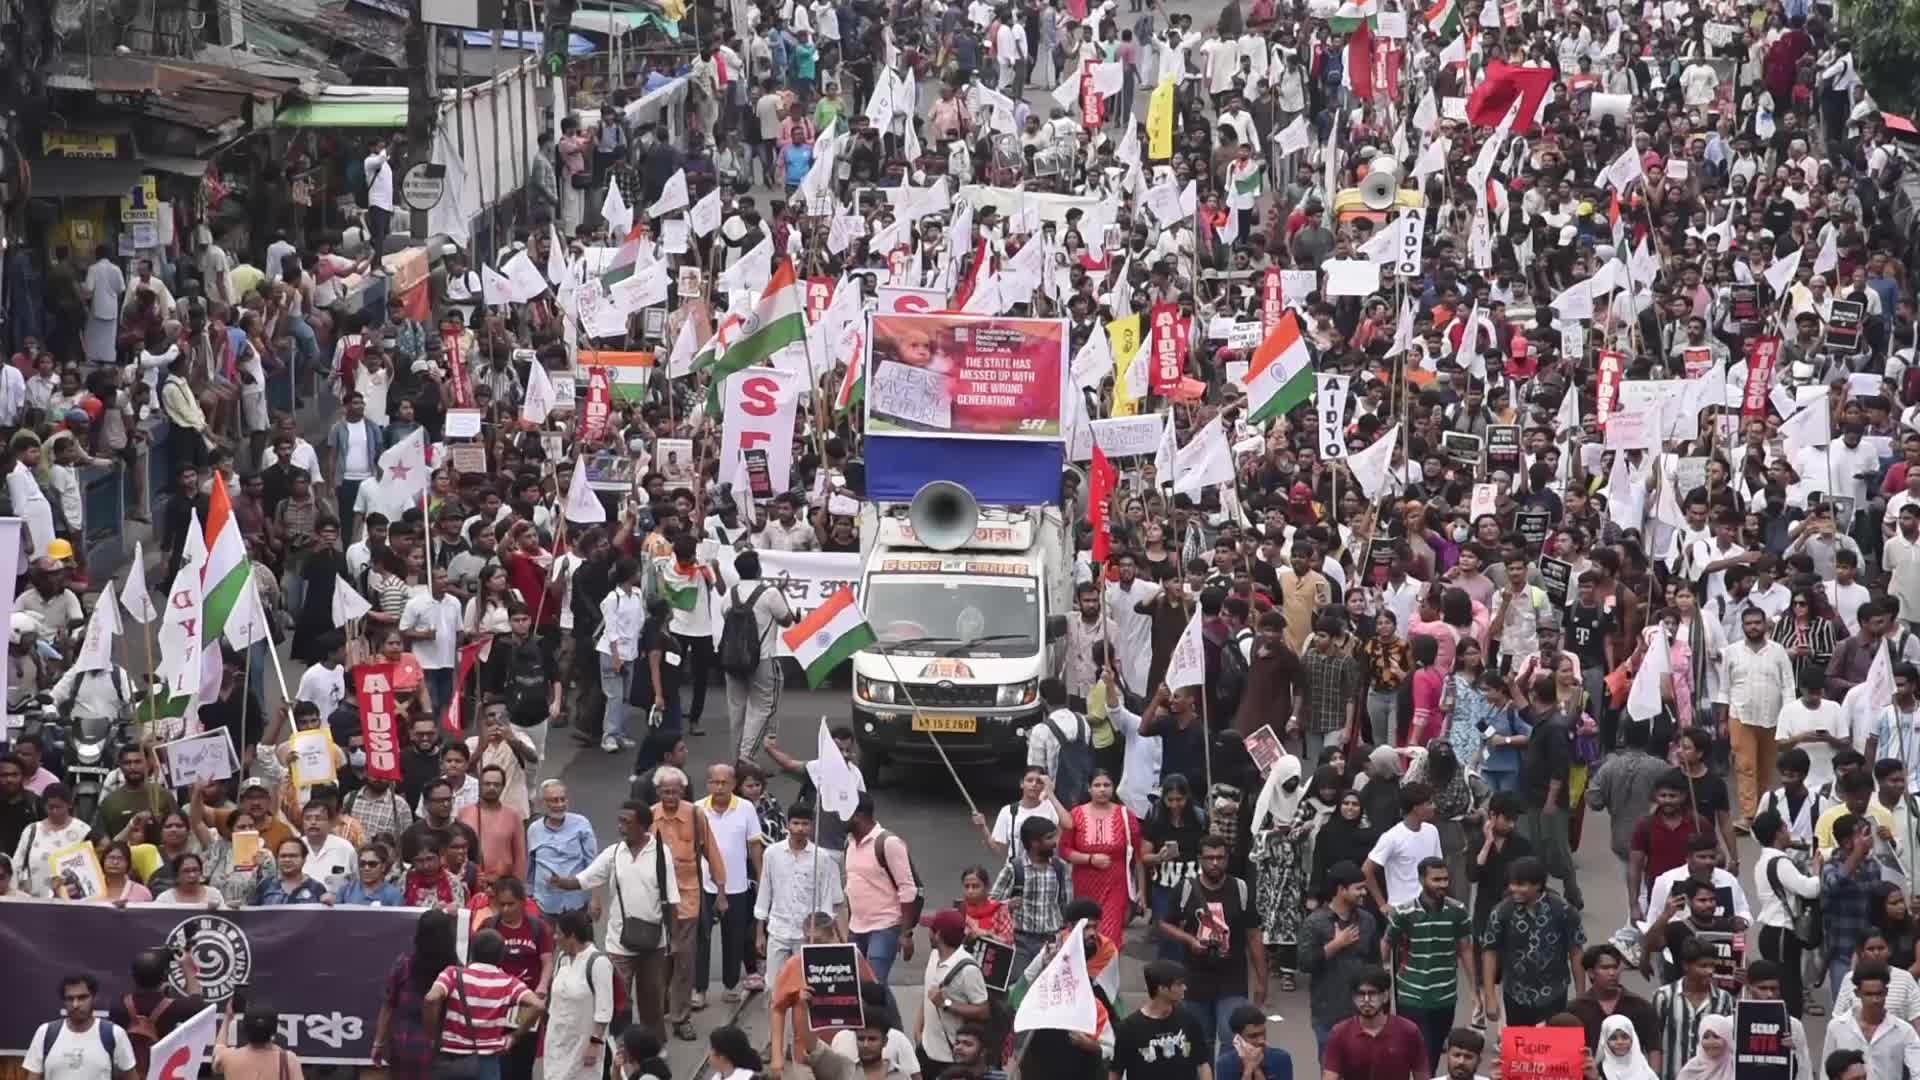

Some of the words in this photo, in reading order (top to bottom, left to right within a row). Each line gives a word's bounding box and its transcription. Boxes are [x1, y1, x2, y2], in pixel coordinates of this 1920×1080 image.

[1400, 209, 1421, 273] AIDYO
[984, 357, 1011, 368] STATE
[1012, 358, 1032, 369] HAS
[1156, 312, 1179, 379] AIDSO
[960, 369, 997, 381] MESSED
[998, 370, 1010, 381] UP
[1011, 371, 1036, 383] WITH
[971, 382, 989, 393] THE
[1747, 342, 1775, 409] AIDSO
[1019, 418, 1048, 431] SFI
[1324, 378, 1341, 457] AIDYO
[363, 673, 396, 772] AIDSO
[1750, 1022, 1780, 1034] SCRAP
